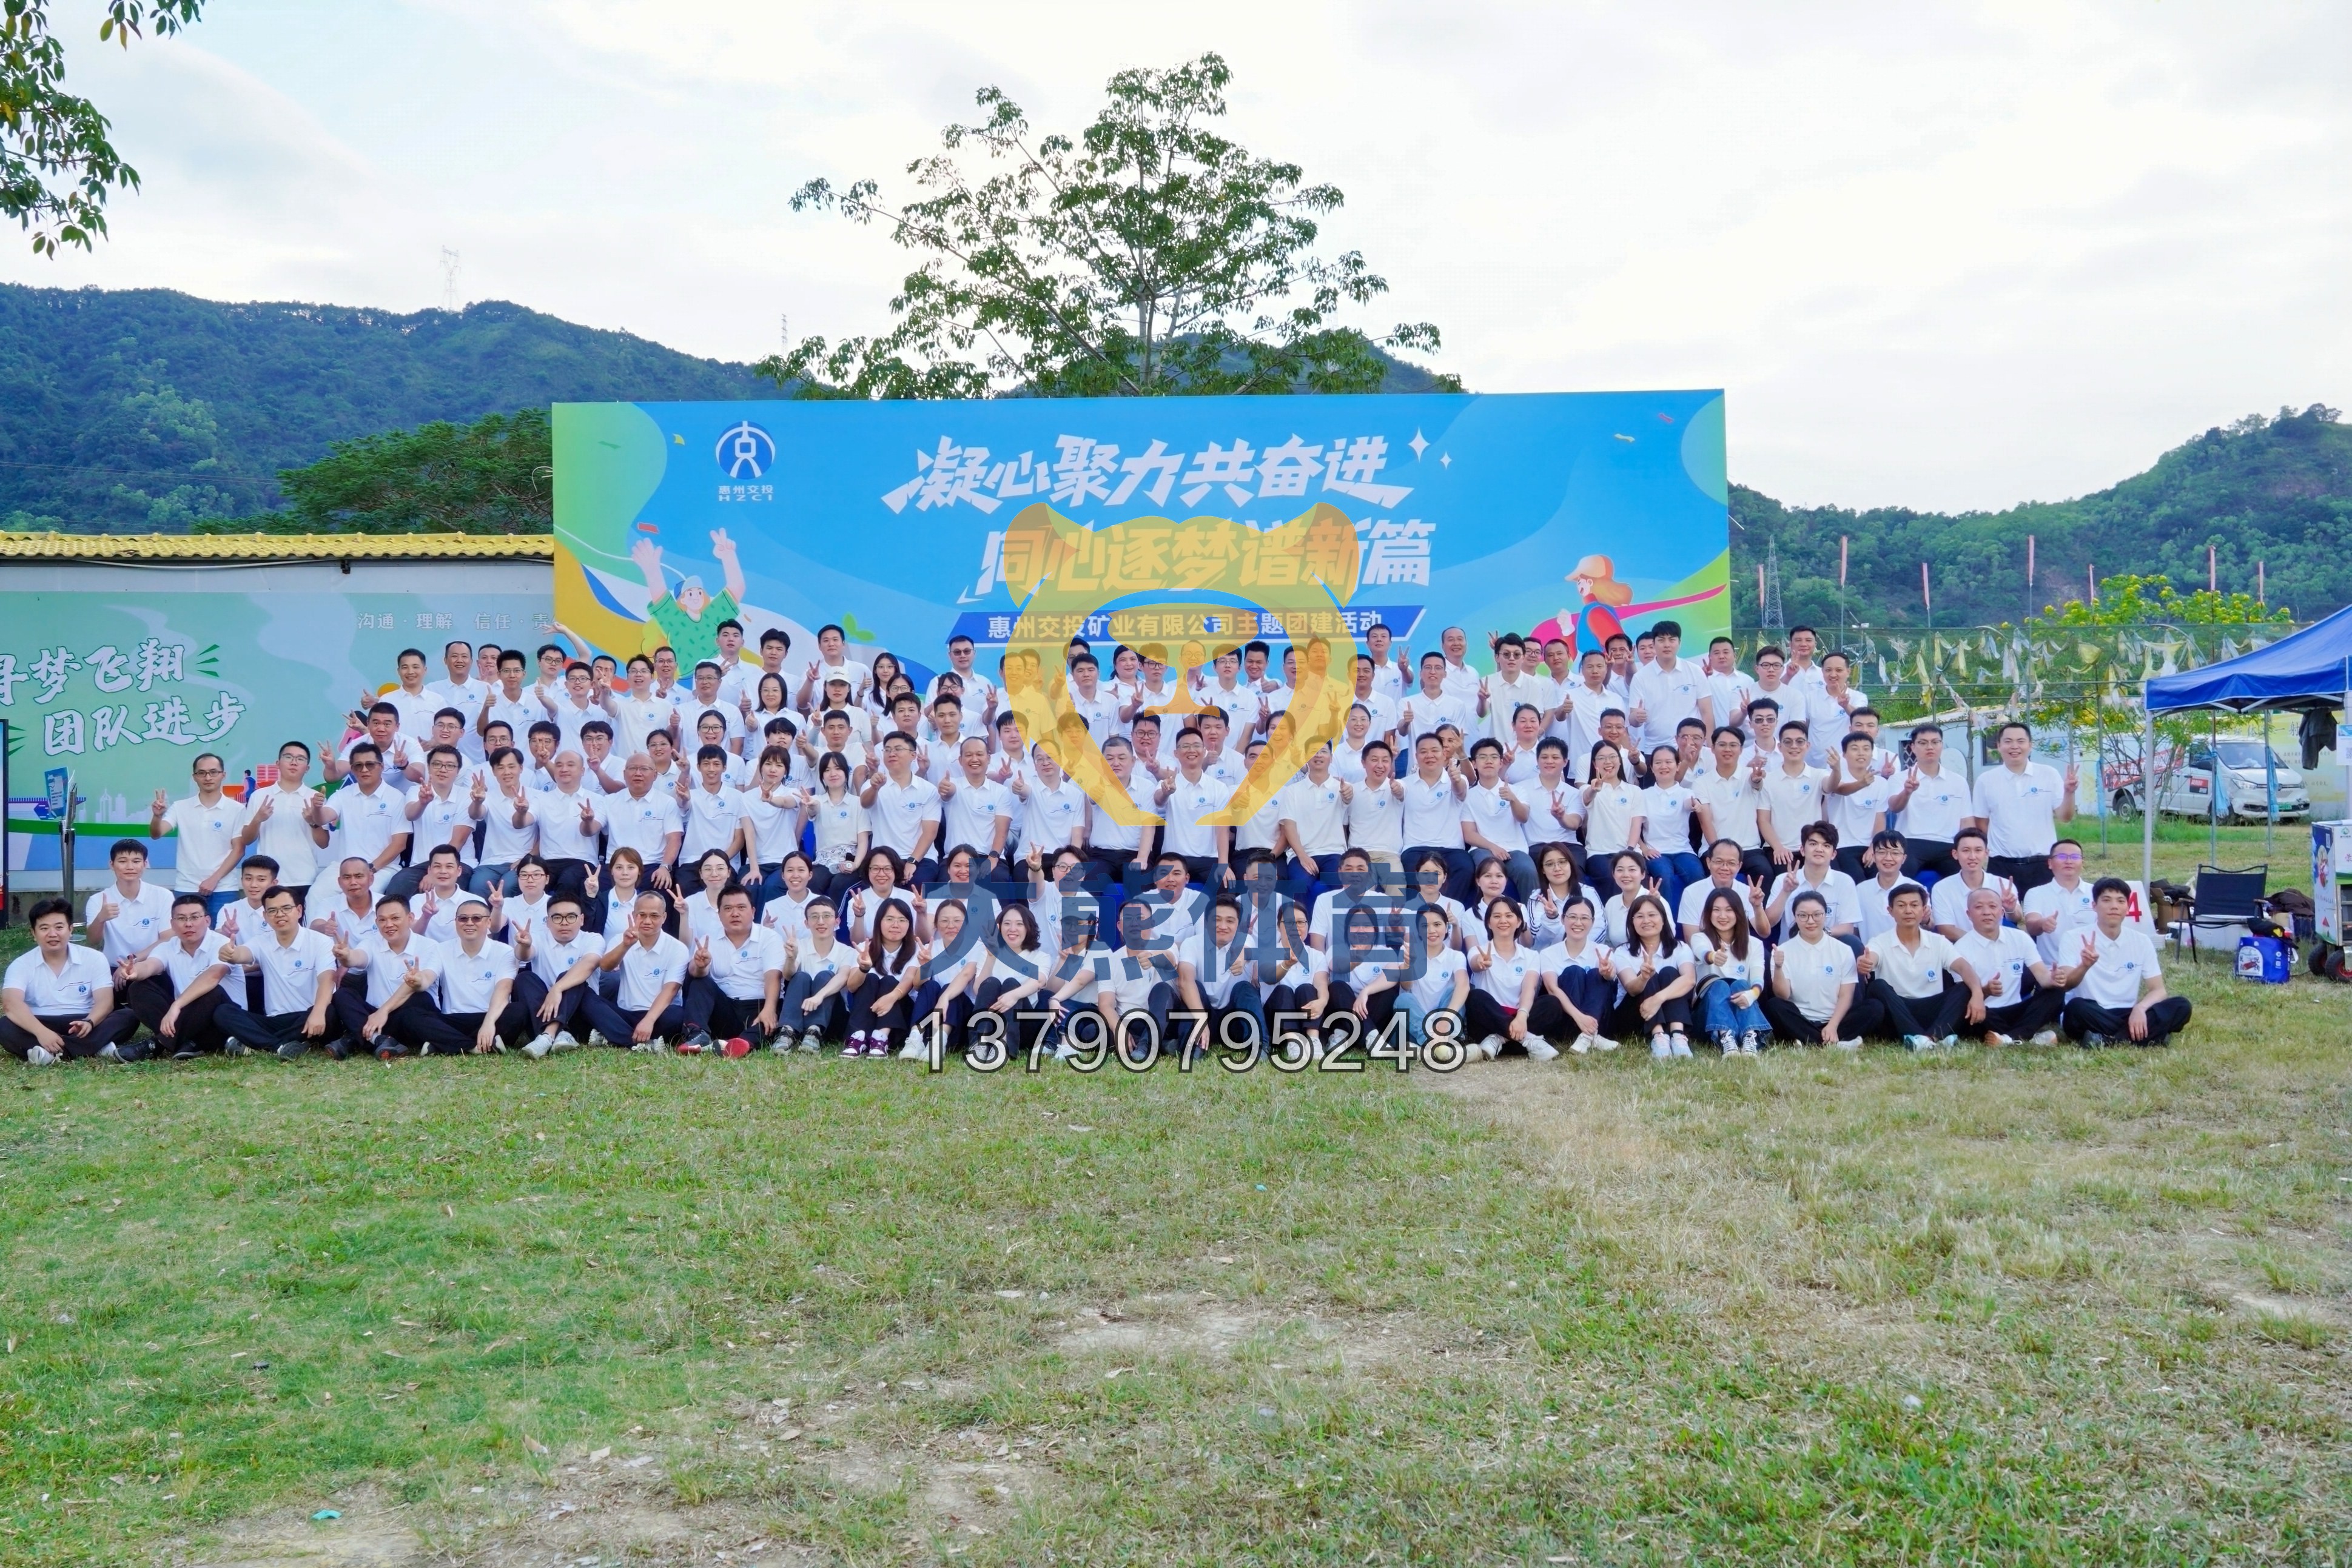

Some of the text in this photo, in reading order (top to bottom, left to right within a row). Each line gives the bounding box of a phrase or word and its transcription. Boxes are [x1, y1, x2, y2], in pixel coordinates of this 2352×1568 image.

[718, 484, 774, 494] 惠州交投
[881, 432, 1415, 514] 凝心聚力共奋进
[956, 517, 1436, 604] 同心逐梦谱新篇
[988, 610, 1382, 638] 惠州交投矿业有限公司主题团建活动
[43, 691, 247, 757] 团队进步
